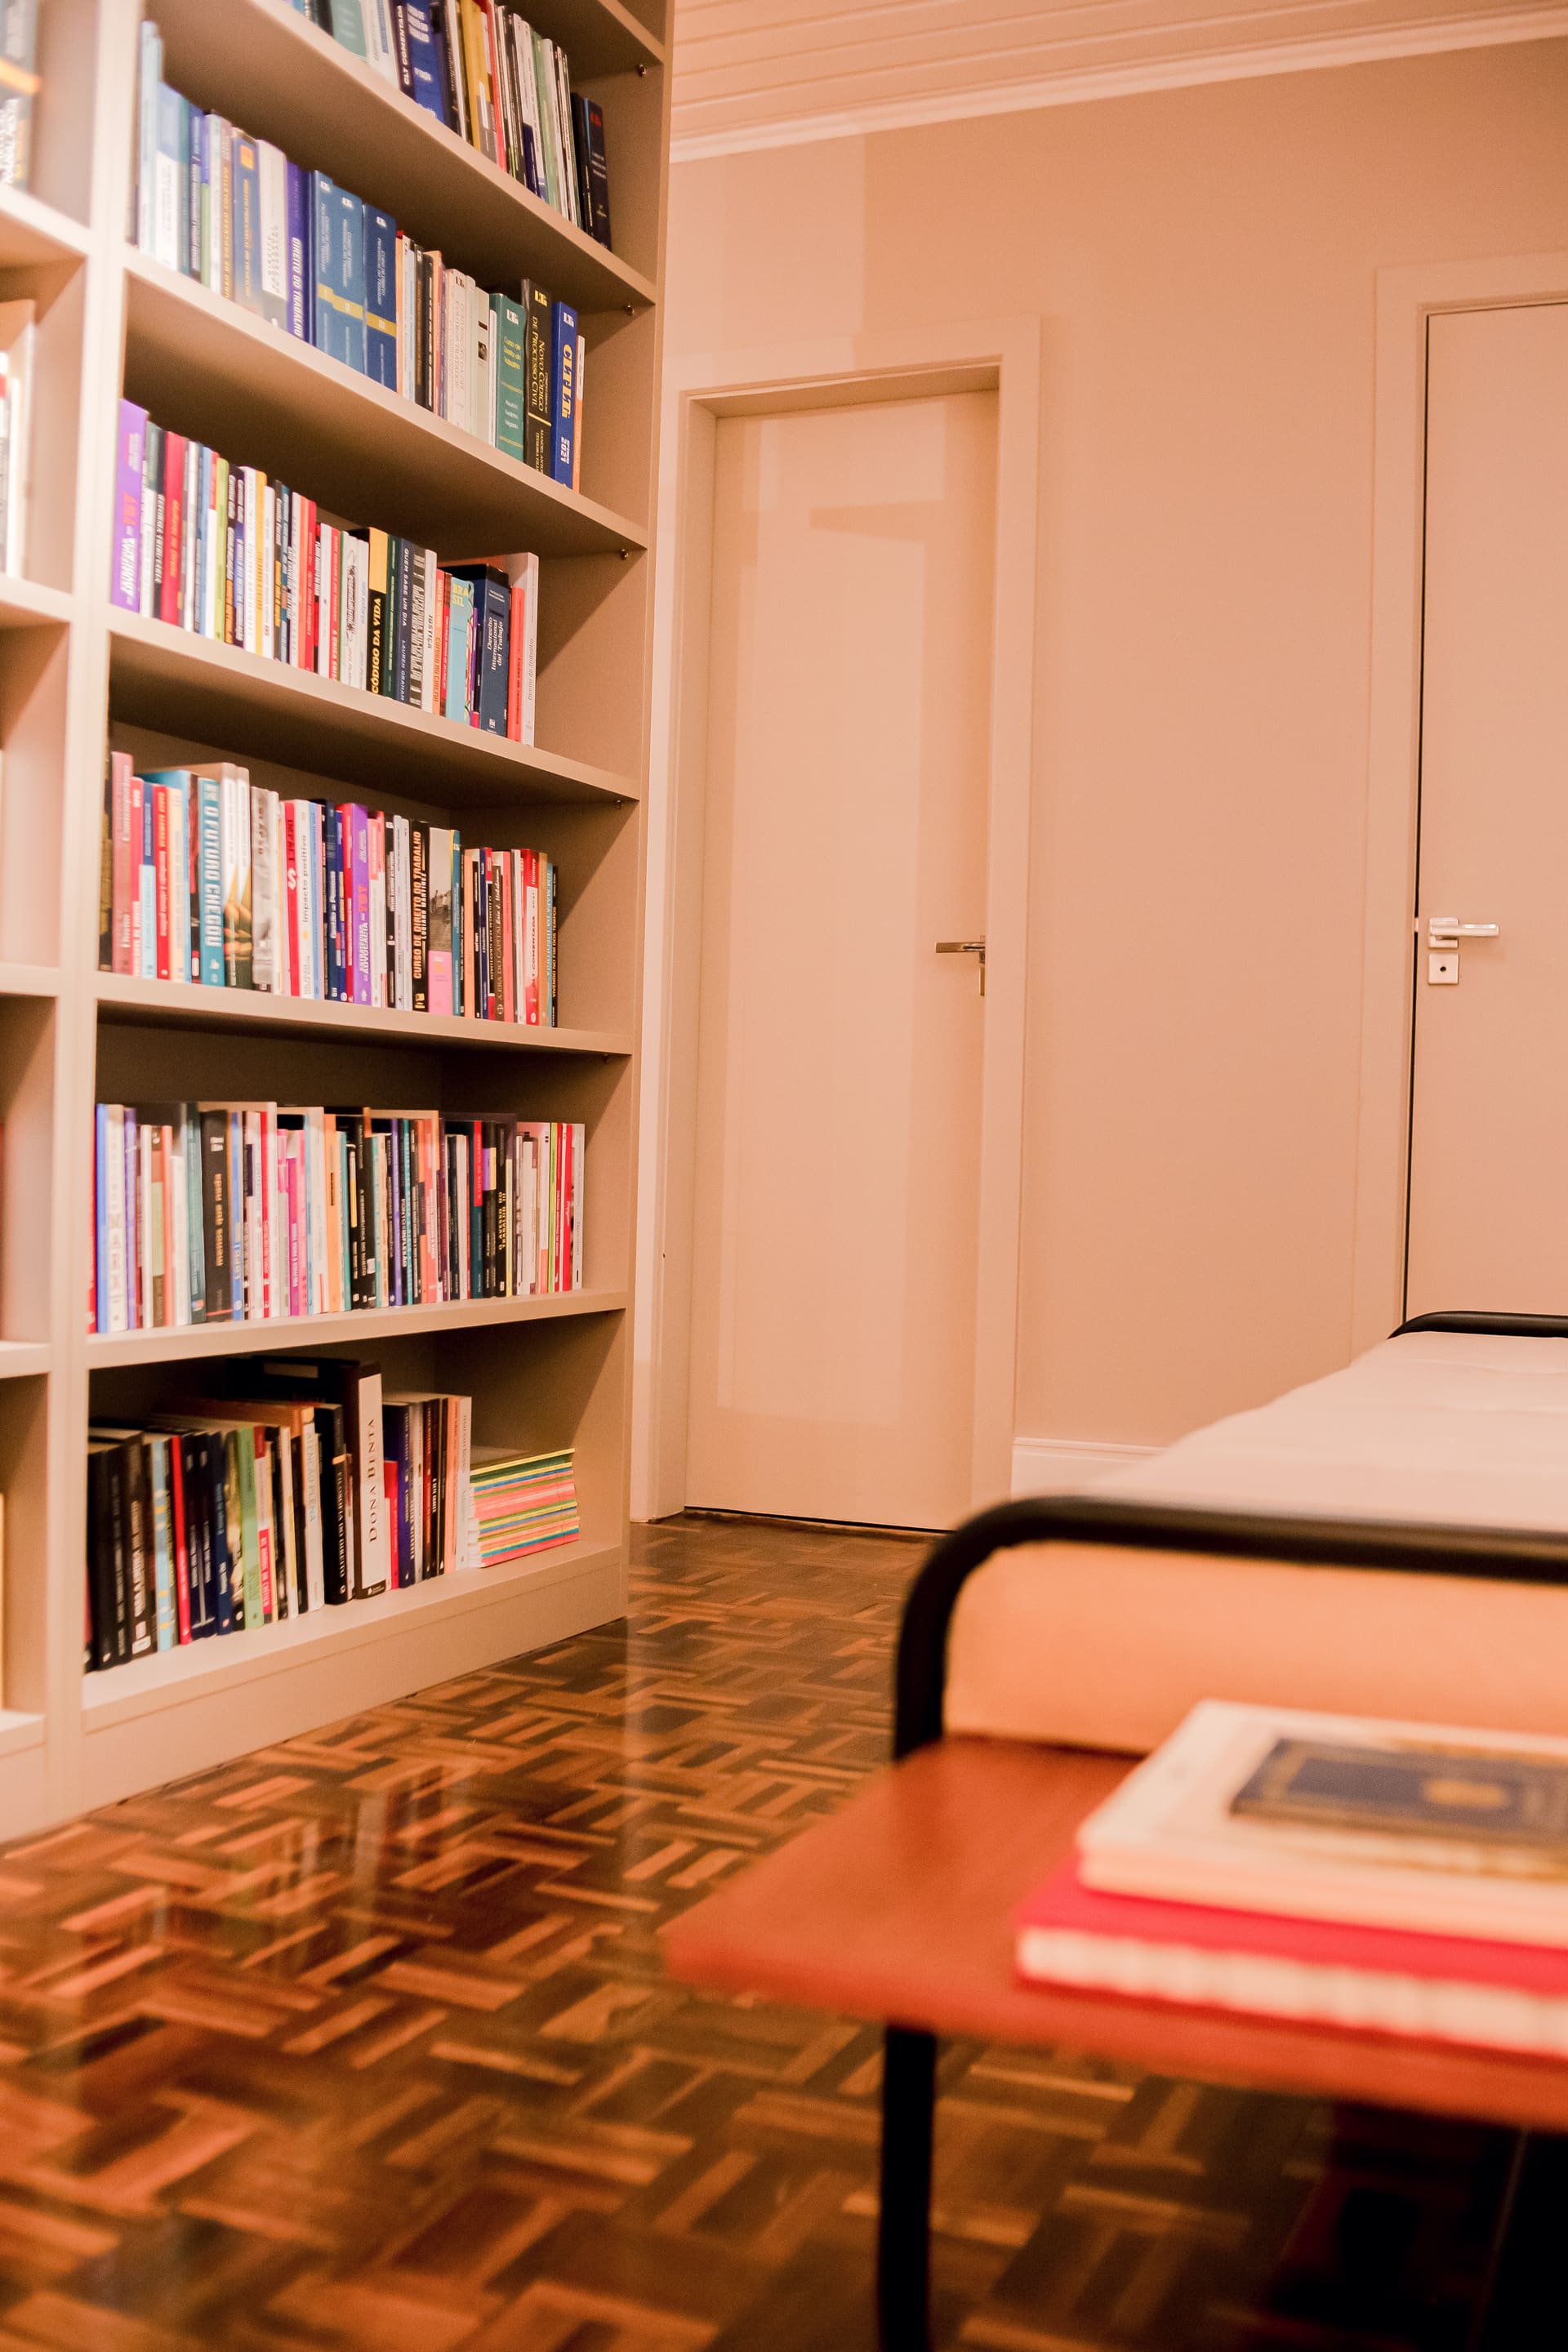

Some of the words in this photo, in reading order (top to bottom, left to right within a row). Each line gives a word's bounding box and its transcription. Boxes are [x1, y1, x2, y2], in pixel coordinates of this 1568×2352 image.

[397, 5, 408, 65] COMENTADA
[292, 237, 302, 274] DIREITO
[293, 277, 302, 288] DO
[293, 287, 303, 336] TRABALHO
[532, 316, 538, 327] DE
[373, 598, 381, 626] VIDA
[403, 598, 408, 610] UM
[372, 630, 381, 648] DA
[370, 649, 381, 694] CÓDIGO
[204, 806, 220, 817] O
[204, 819, 220, 880] FUTURO
[412, 831, 421, 882] TRABALHO
[413, 884, 421, 898] DO
[204, 884, 222, 947] CHEGOU
[413, 899, 421, 933] DIREITO
[413, 933, 421, 945] DE
[413, 947, 422, 979] CURSO
[496, 960, 502, 974] DO
[213, 1173, 222, 1202] nada
[215, 1204, 225, 1226] que
[215, 1228, 224, 1267] menos
[368, 1418, 376, 1478] BENTA
[336, 1472, 345, 1521] FILOSOFIA
[338, 1522, 345, 1537] DO
[368, 1487, 378, 1543] DONA
